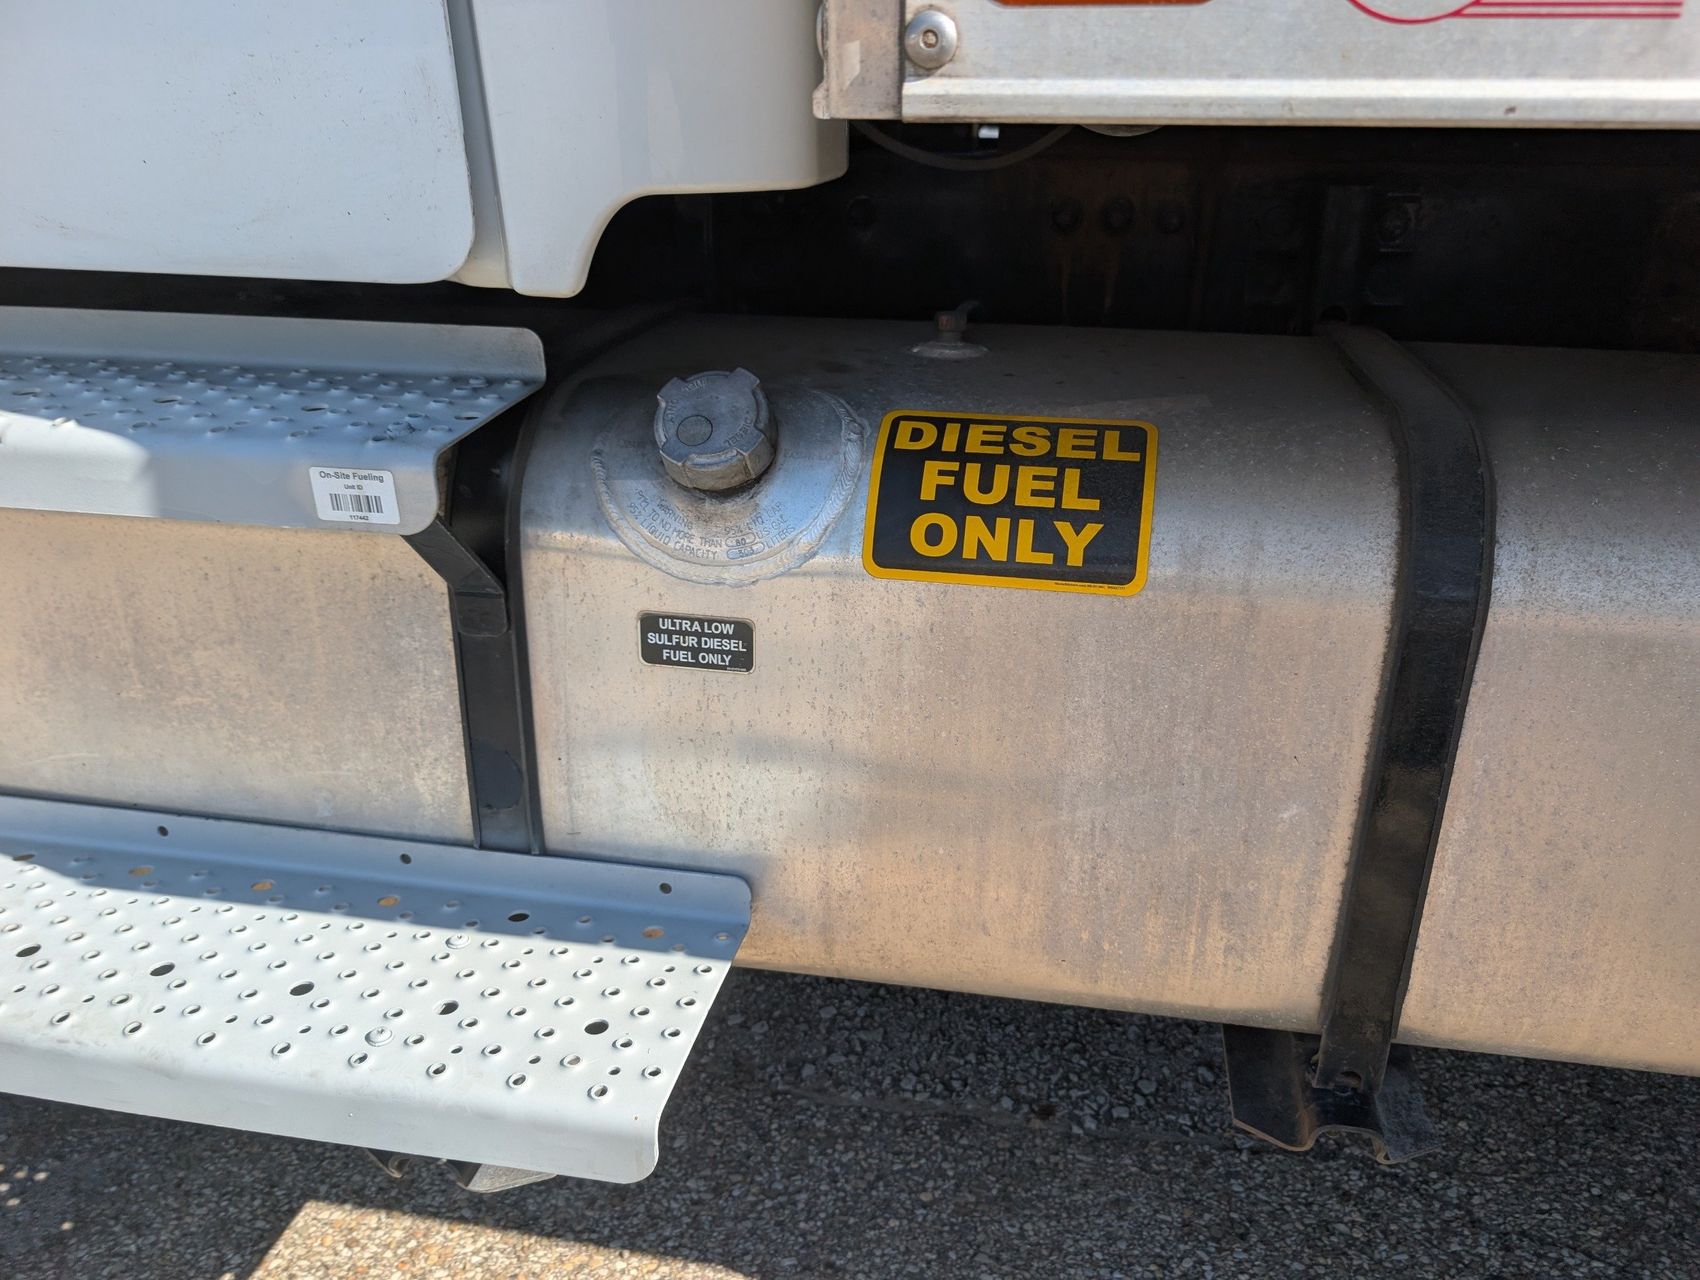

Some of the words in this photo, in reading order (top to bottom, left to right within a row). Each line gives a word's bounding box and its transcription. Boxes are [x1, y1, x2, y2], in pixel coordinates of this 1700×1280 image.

[725, 417, 754, 446] DIESEL
[893, 420, 1142, 462] DIESEL
[318, 470, 351, 480] On-Site
[352, 472, 384, 484] Fueling
[919, 460, 1101, 511] FUEL
[627, 502, 642, 520] 95%
[640, 518, 671, 545] LIQUID
[673, 541, 718, 559] CAPACITY
[672, 527, 696, 544] MORE
[699, 536, 722, 548] THAN
[764, 525, 796, 549] LITERS
[909, 512, 1105, 567] ONLY
[735, 538, 747, 547] 80
[658, 618, 702, 633] ULTRA
[703, 621, 735, 635] LOW
[647, 632, 698, 648] SULFUR
[701, 637, 747, 652] DIESEL
[662, 649, 696, 663] FUEL
[698, 652, 732, 666] ONLY
